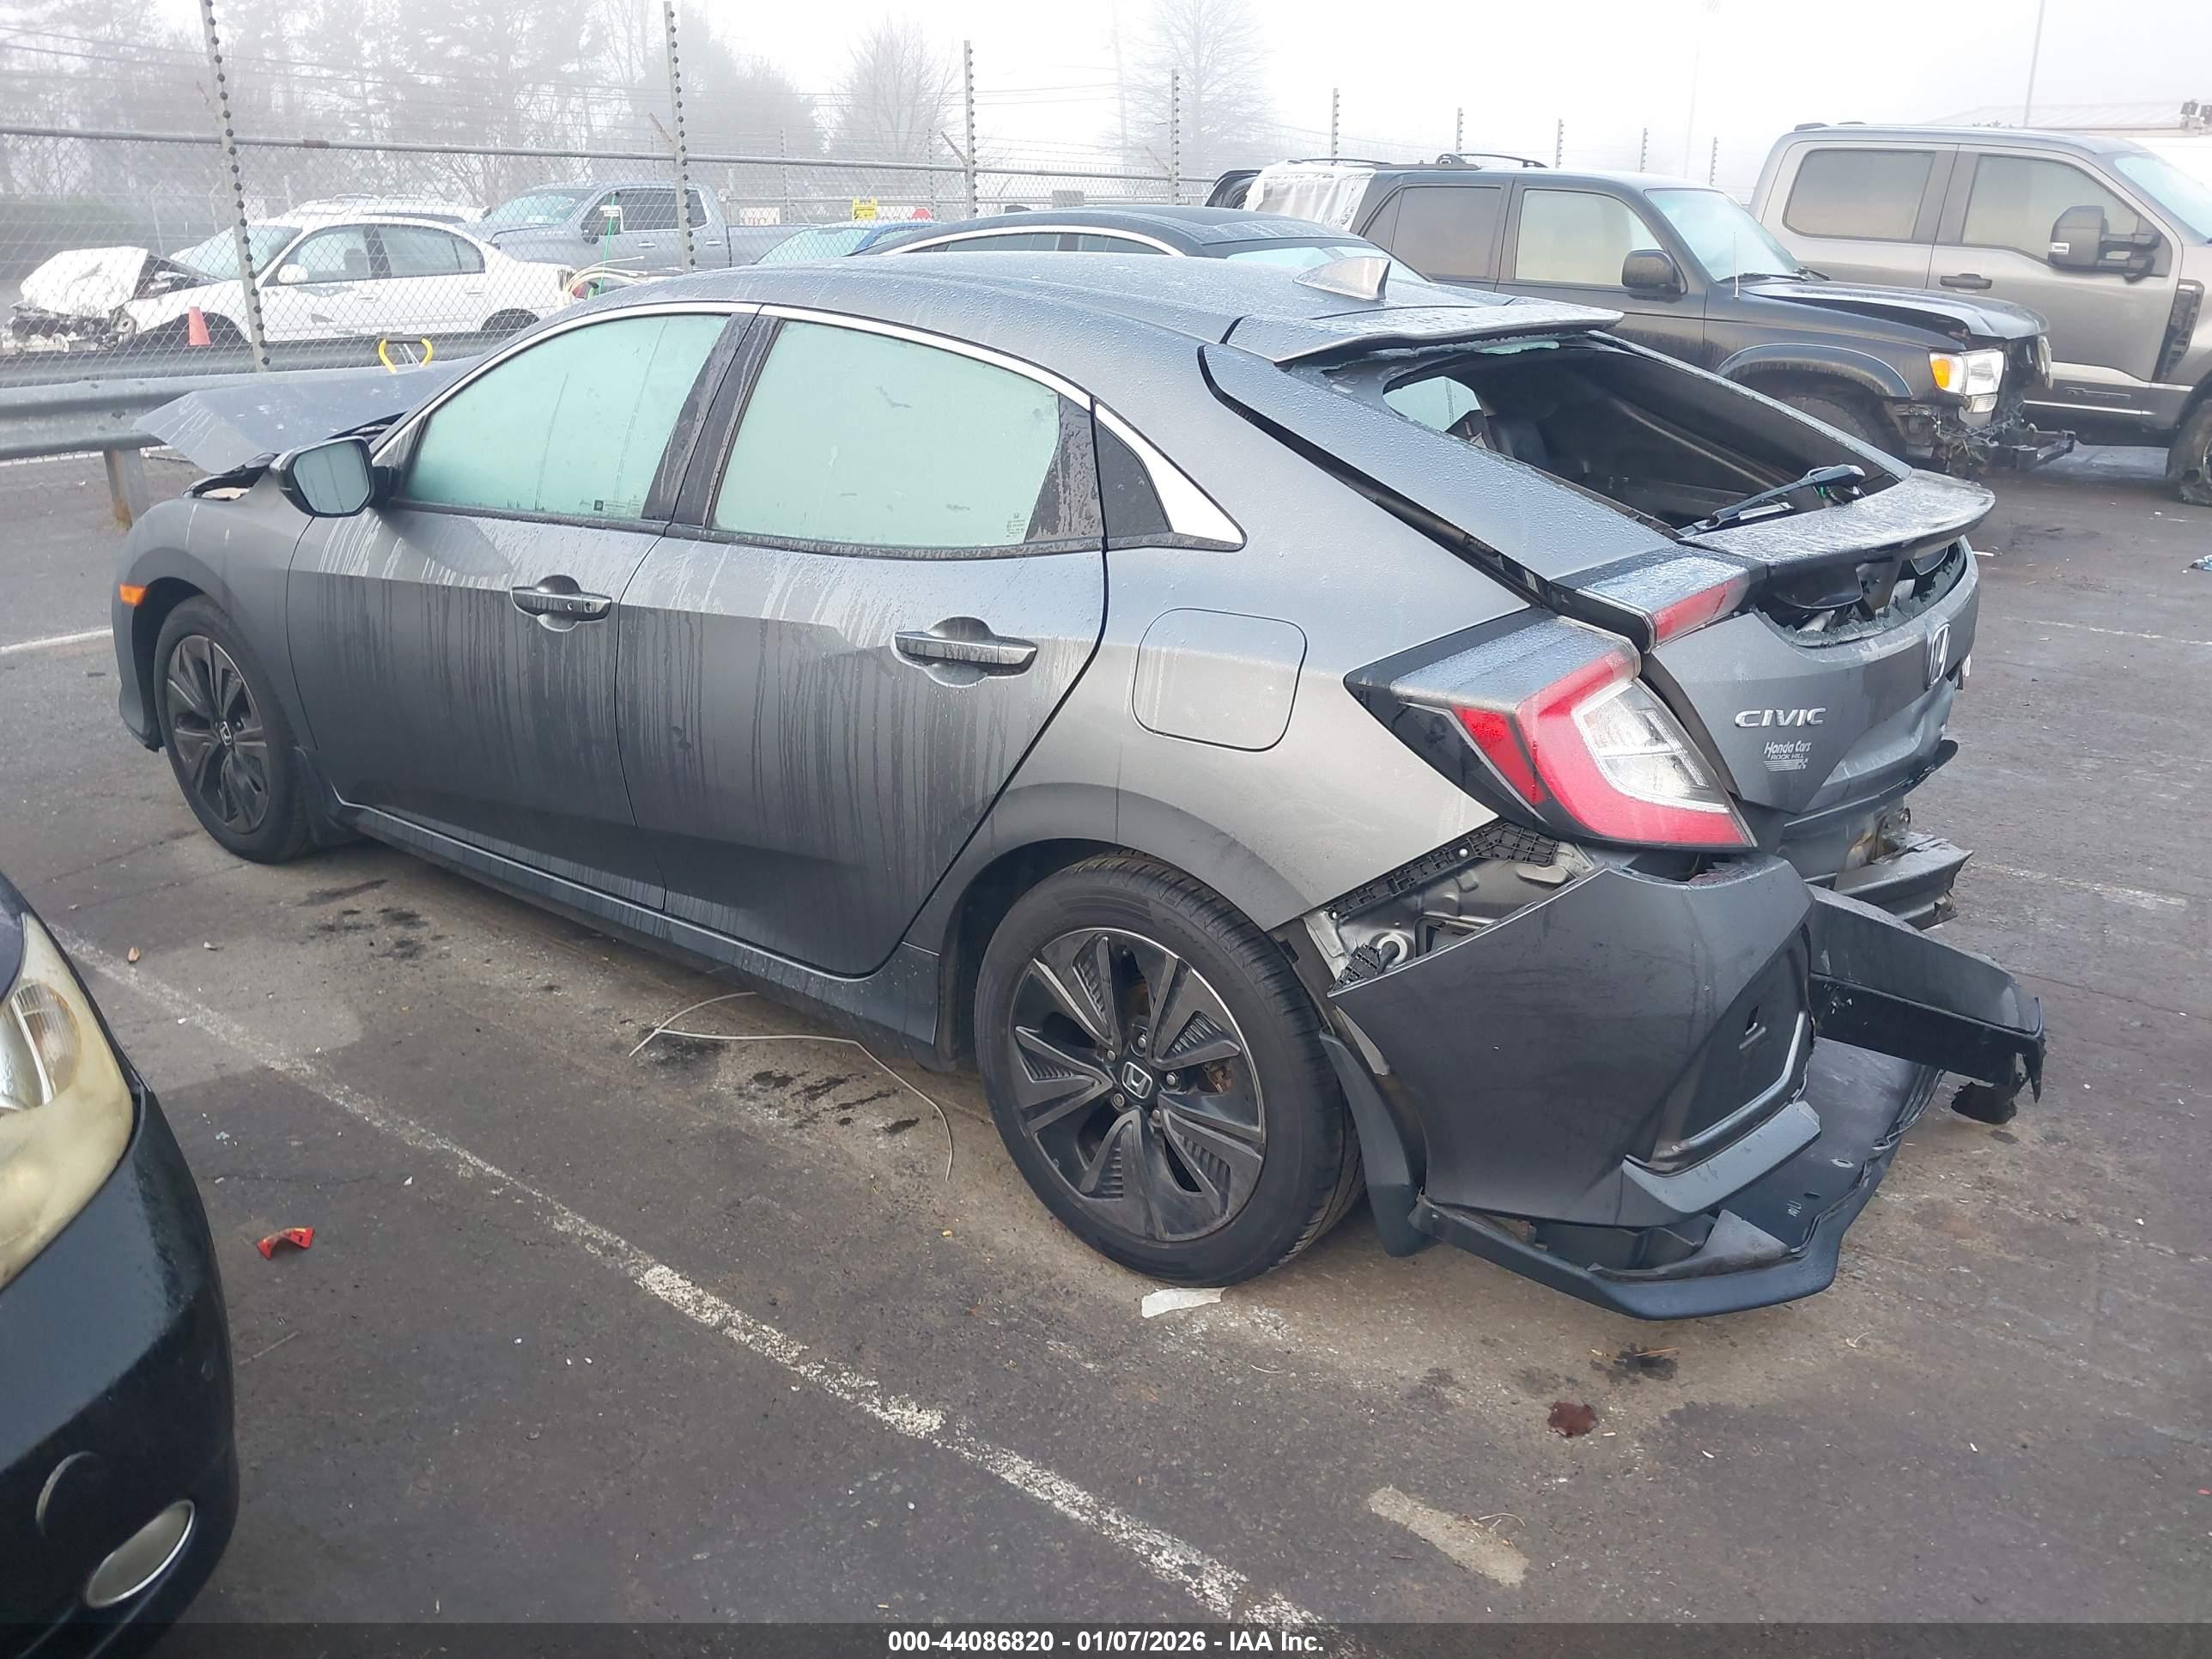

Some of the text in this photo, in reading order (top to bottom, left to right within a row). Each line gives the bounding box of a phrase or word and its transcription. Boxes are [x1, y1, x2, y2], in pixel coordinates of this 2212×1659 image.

[1735, 708, 1826, 727] CIVIC
[1764, 740, 1812, 758] Honda Cars
